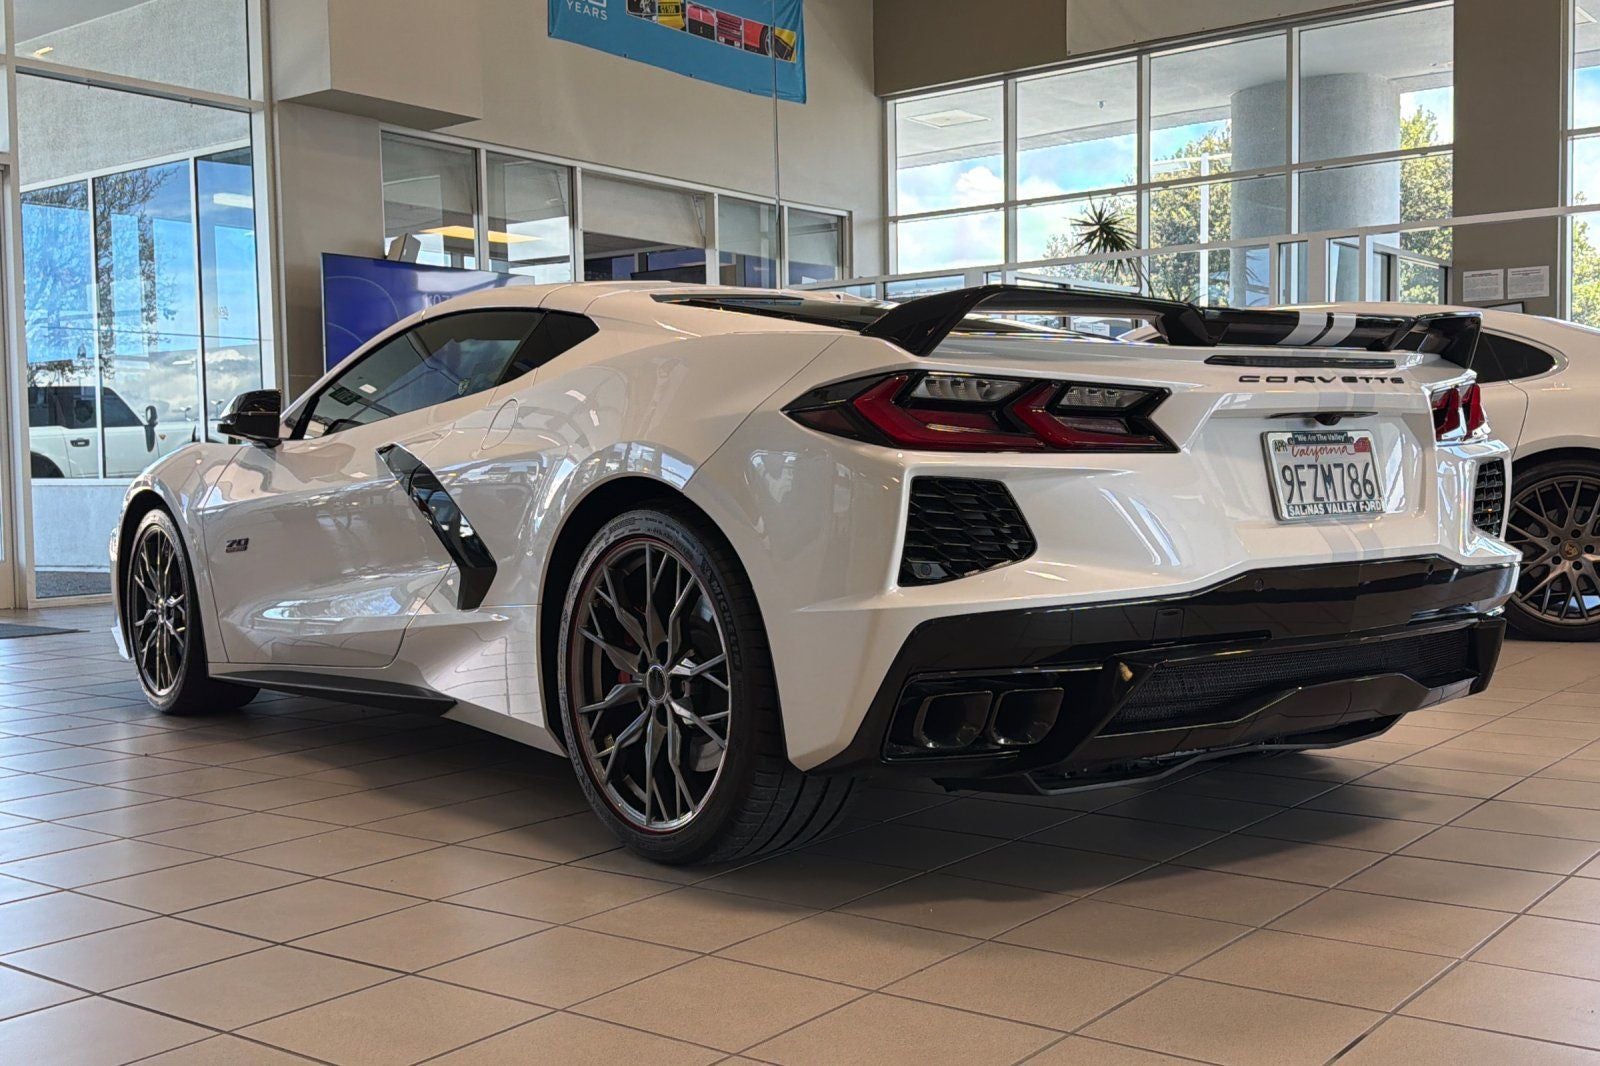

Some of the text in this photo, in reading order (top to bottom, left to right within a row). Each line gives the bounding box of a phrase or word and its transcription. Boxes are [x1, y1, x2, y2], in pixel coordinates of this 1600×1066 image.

[566, 0, 608, 20] YEARS
[1238, 375, 1405, 384] CORVETTE
[1316, 433, 1327, 442] The
[1291, 445, 1355, 462] California
[1281, 463, 1375, 504] 9FZM786
[1326, 501, 1357, 515] VALLEY
